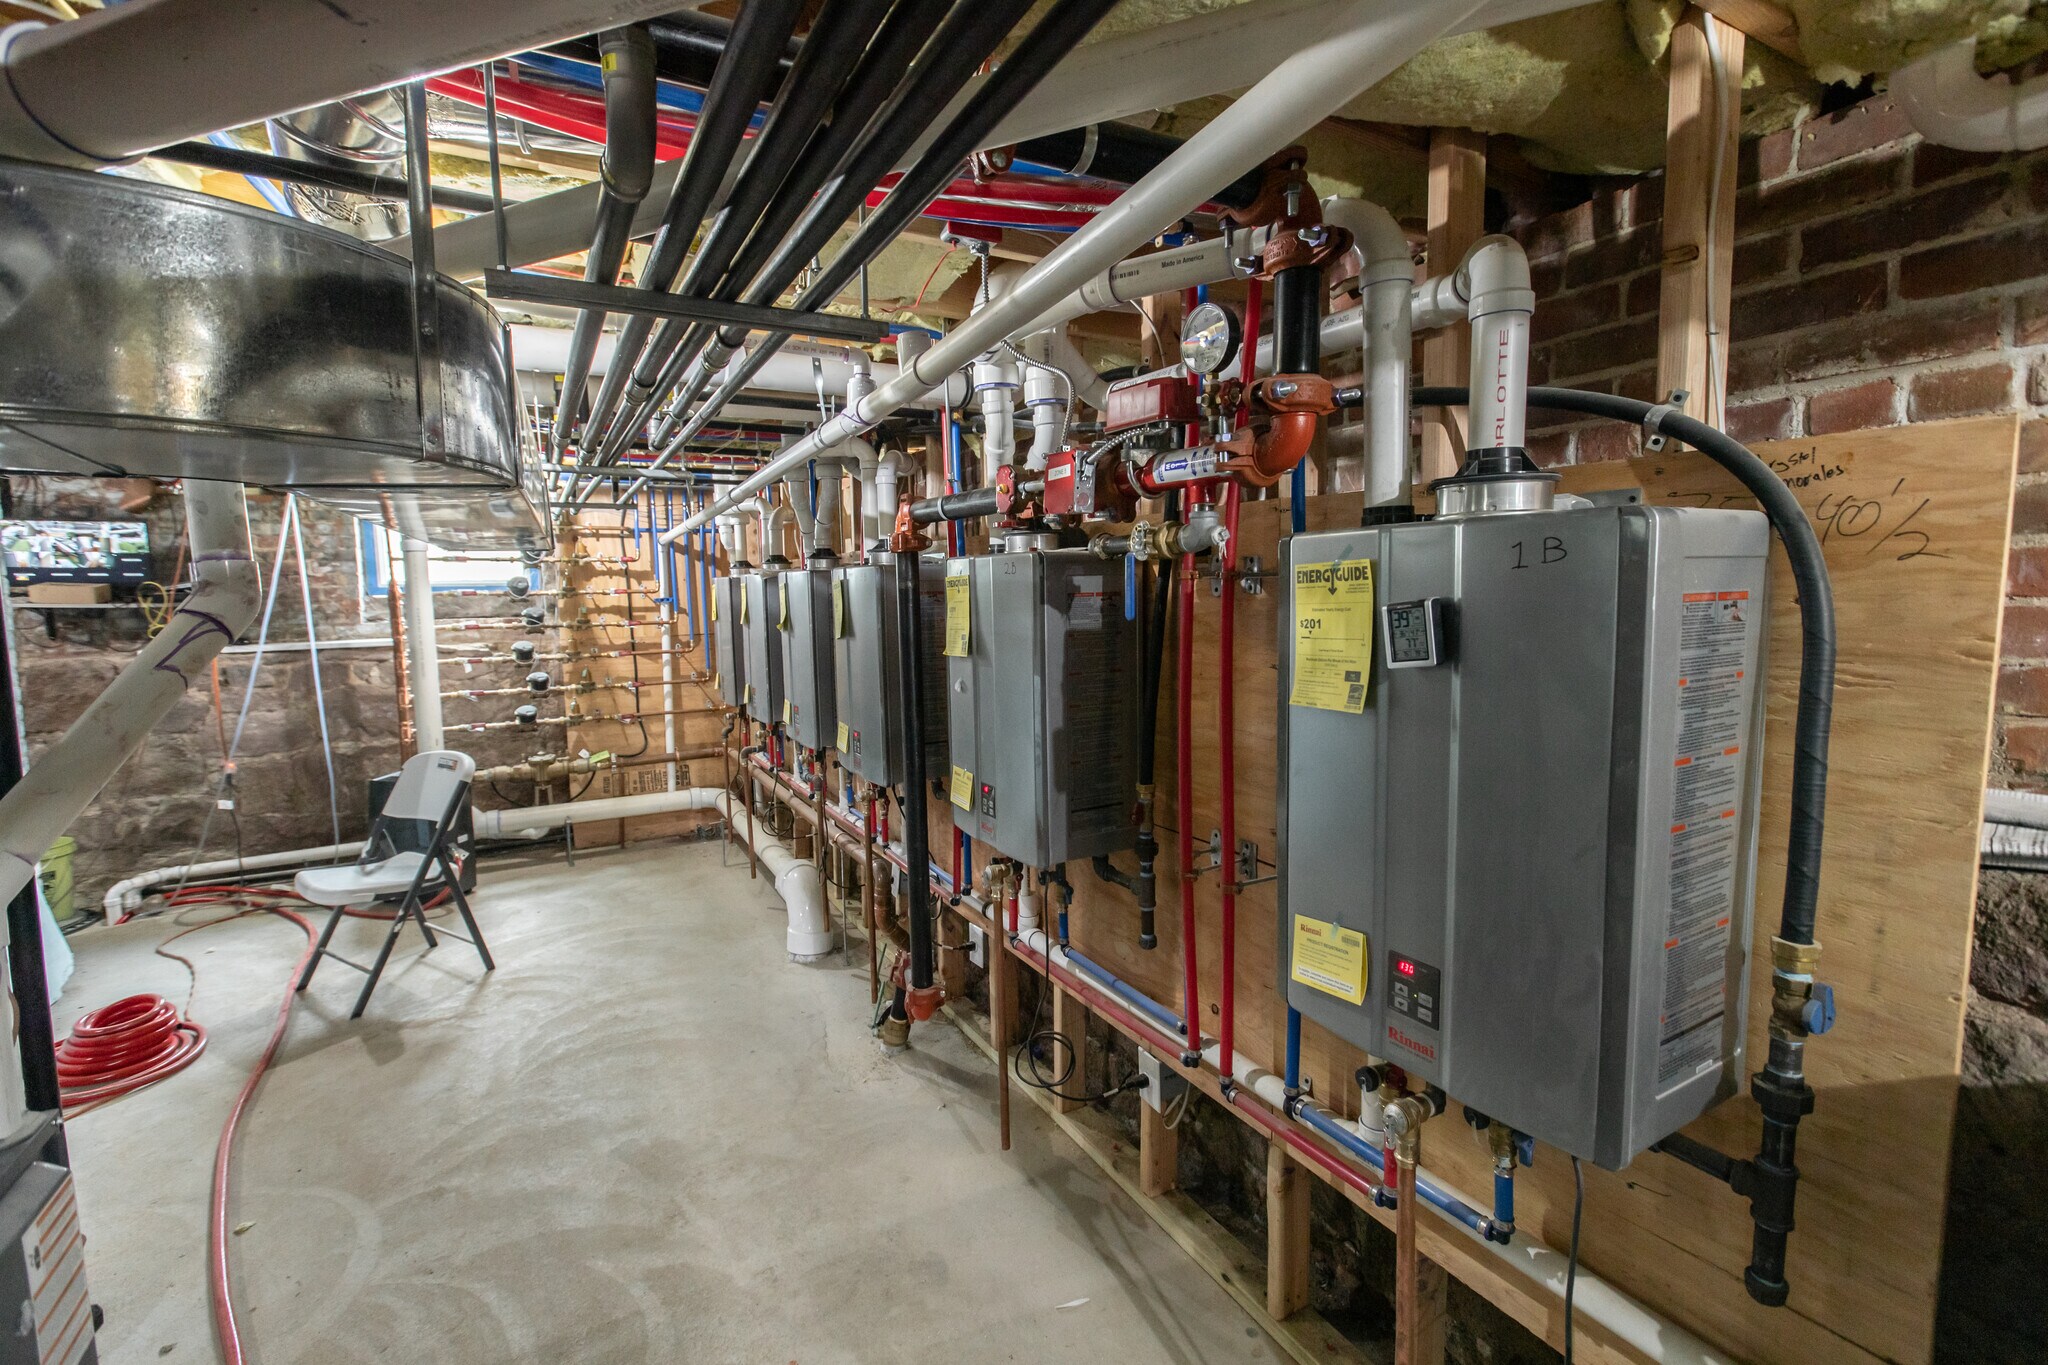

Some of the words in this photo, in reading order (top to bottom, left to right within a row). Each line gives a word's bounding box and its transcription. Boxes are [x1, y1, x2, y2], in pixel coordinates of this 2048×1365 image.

[1161, 260, 1175, 269] Made
[1182, 253, 1204, 264] America
[1296, 566, 1369, 586] ENERGYGUIDE
[1300, 618, 1322, 630] $201
[1388, 1026, 1436, 1059] Rinnai
